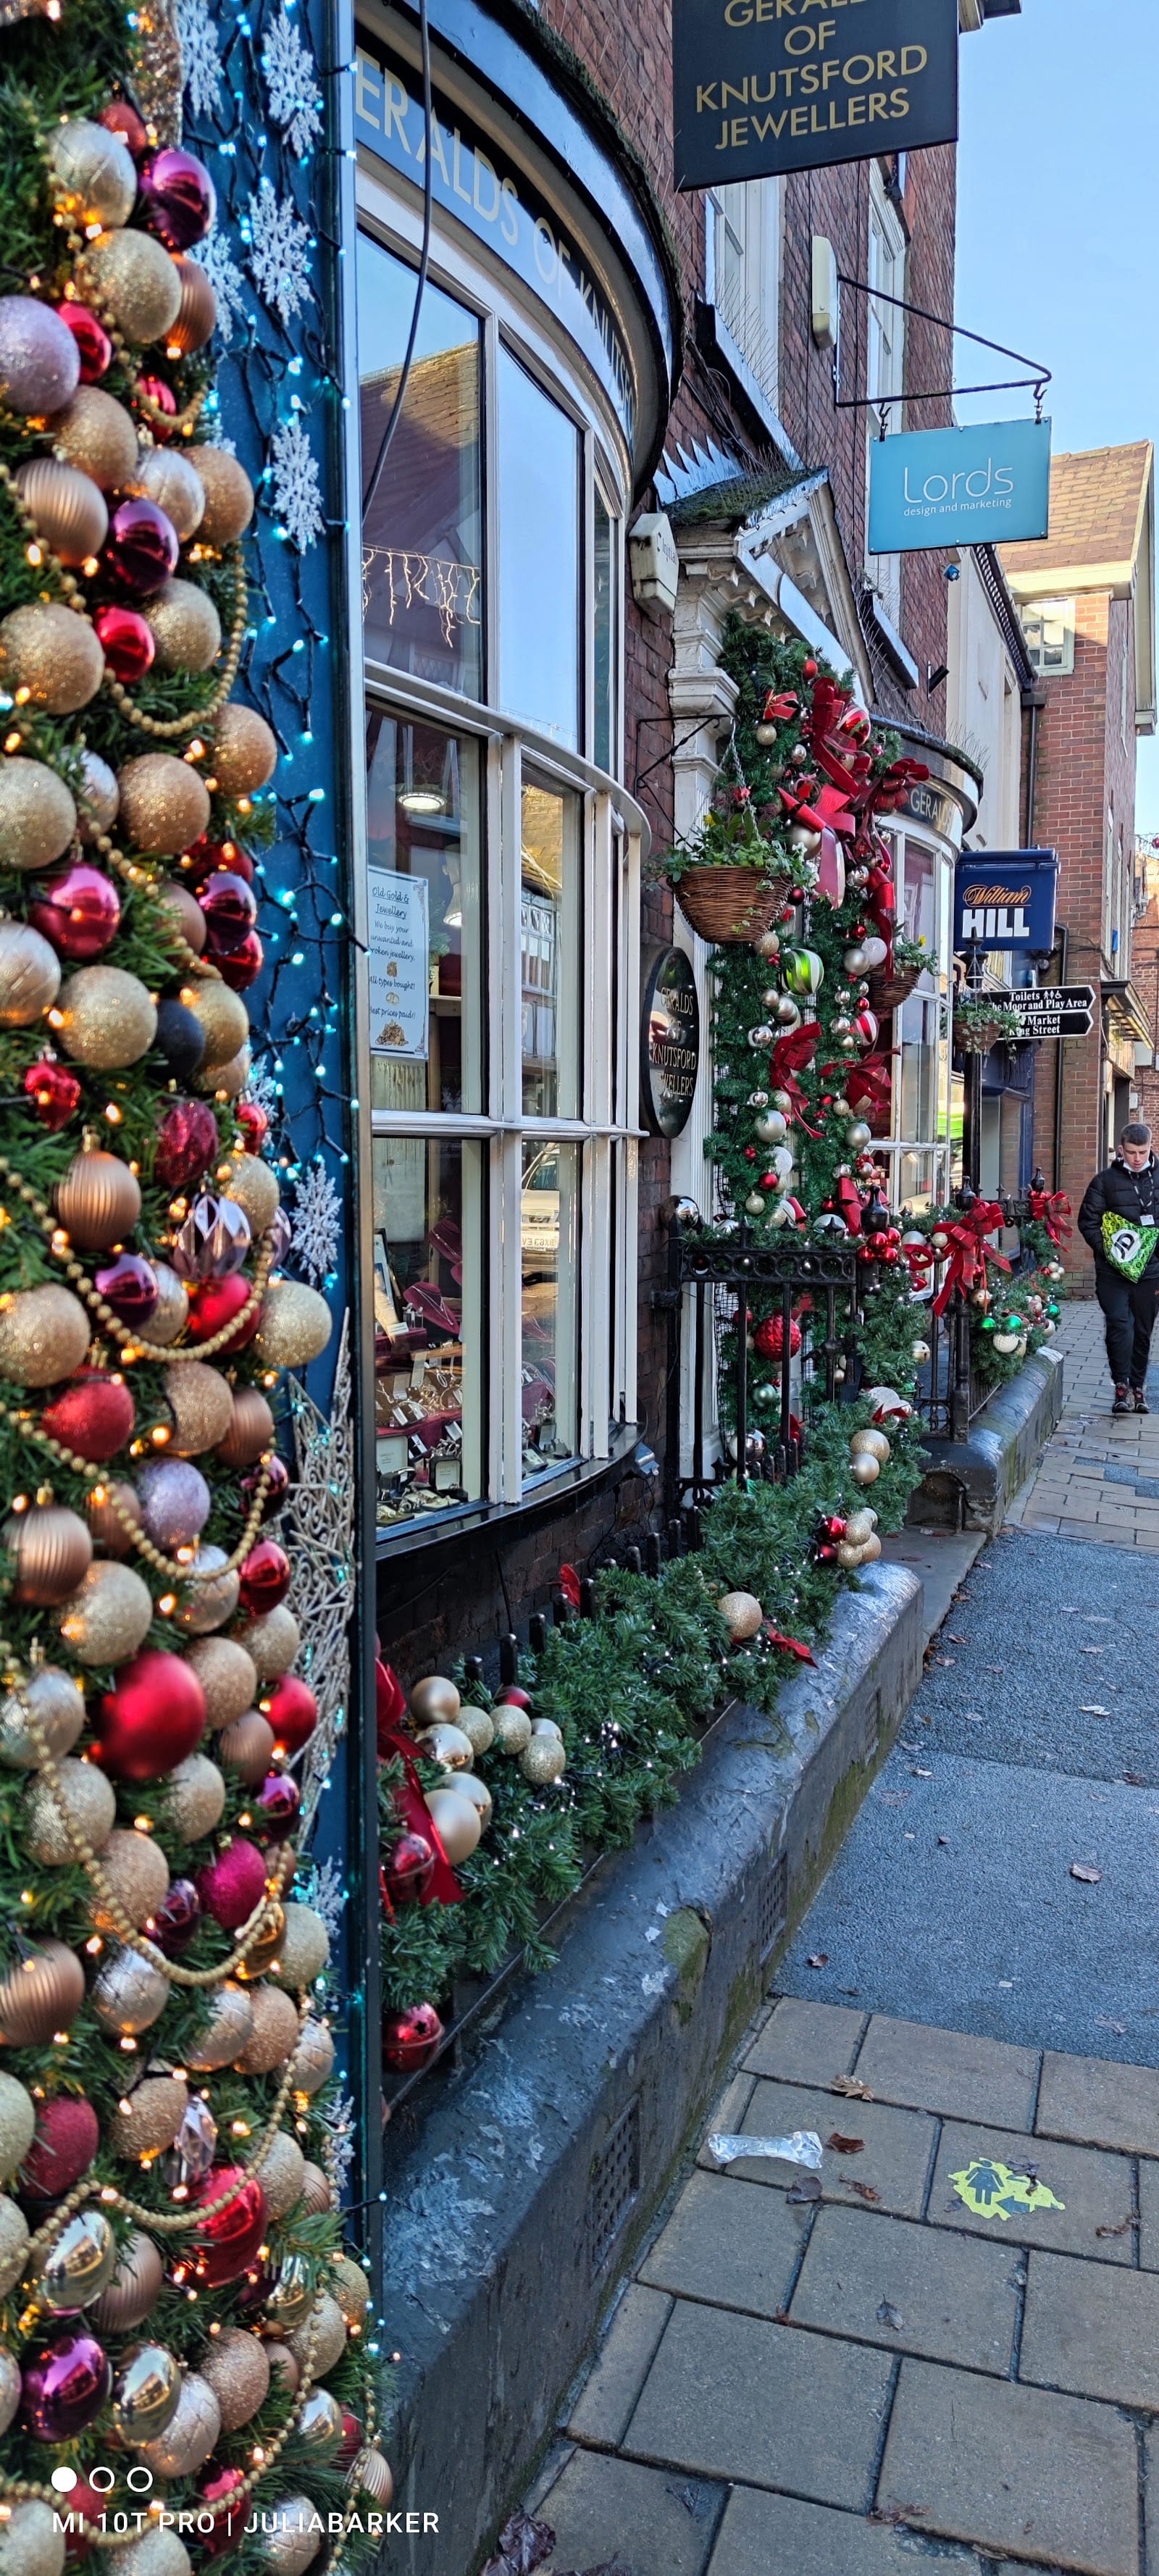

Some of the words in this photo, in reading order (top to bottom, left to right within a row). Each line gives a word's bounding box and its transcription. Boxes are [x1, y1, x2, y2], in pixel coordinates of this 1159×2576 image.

[784, 20, 836, 55] OF
[696, 45, 927, 112] KNUTSFORD
[715, 88, 909, 150] JEWELLERS
[356, 45, 519, 246] ERALDS
[533, 217, 571, 298] OF
[904, 458, 1013, 503] Lords
[904, 506, 937, 517] design
[939, 503, 958, 514] and
[961, 498, 1012, 511] marketing
[372, 886, 385, 897] Old
[387, 890, 403, 901] Gold
[963, 885, 1032, 907] William
[376, 903, 407, 920] Jewellery
[385, 921, 395, 933] buy
[962, 908, 1029, 938] HILL
[370, 934, 401, 945] unwanted
[369, 946, 389, 956] roken
[378, 977, 393, 989] types
[661, 987, 693, 1016] GERALDS
[1003, 1001, 1027, 1012] Moor
[1028, 1000, 1044, 1010] and
[1045, 1000, 1065, 1010] Play
[1066, 998, 1087, 1008] Area
[1009, 991, 1040, 1002] Toilets
[381, 1008, 398, 1019] prices
[1026, 1015, 1060, 1026] Market
[1009, 1026, 1030, 1037] Kng
[1032, 1025, 1060, 1035] Street
[653, 1042, 697, 1070] KNUTSFORD
[1114, 1233, 1135, 1260] JD
